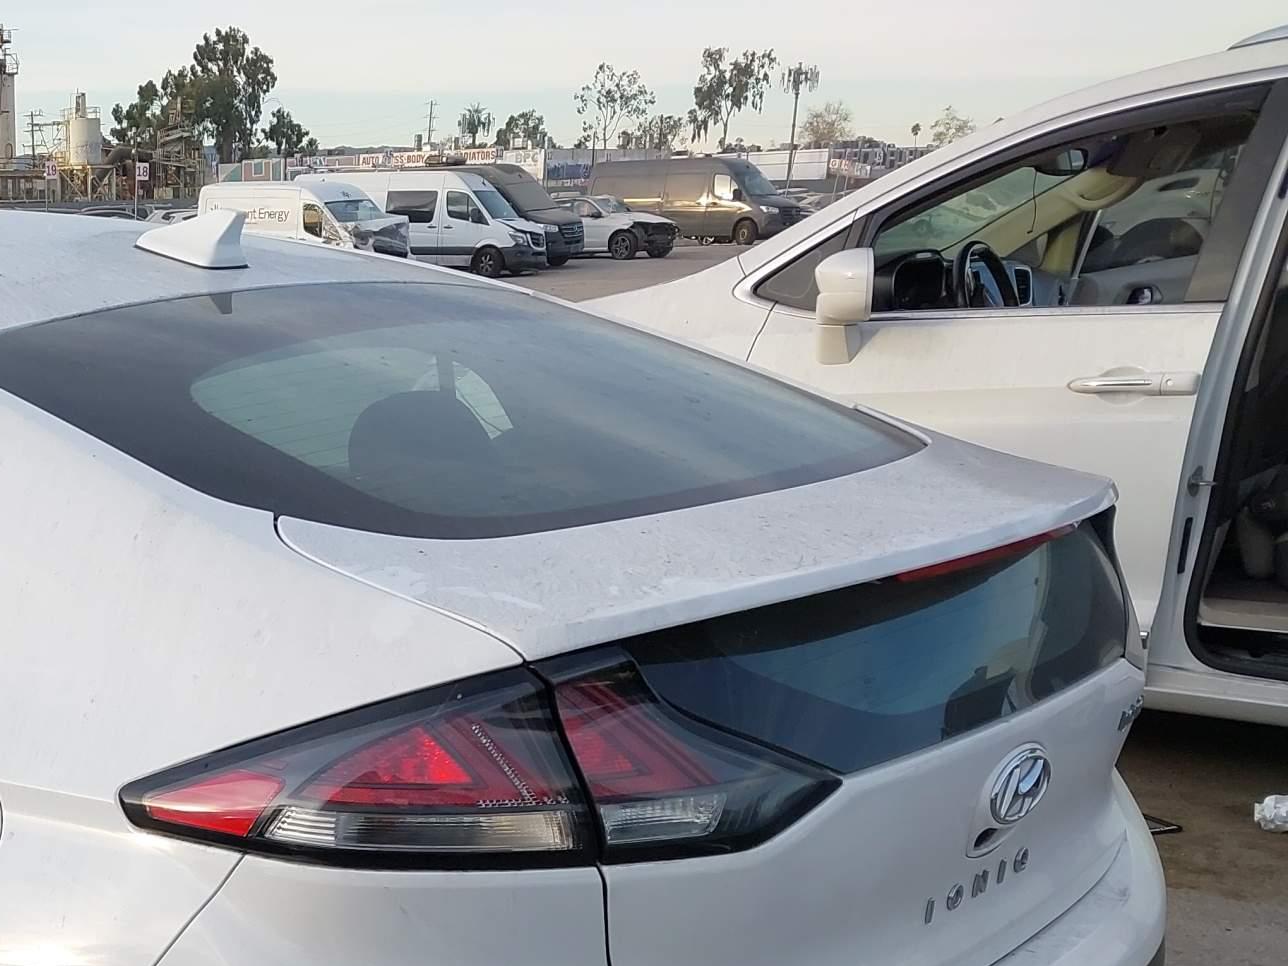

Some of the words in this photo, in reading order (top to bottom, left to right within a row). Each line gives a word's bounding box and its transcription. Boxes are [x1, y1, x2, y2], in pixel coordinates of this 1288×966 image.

[46, 165, 57, 176] 19
[136, 166, 148, 177] 18
[258, 203, 290, 222] Energy
[925, 847, 1030, 925] IONIQ
